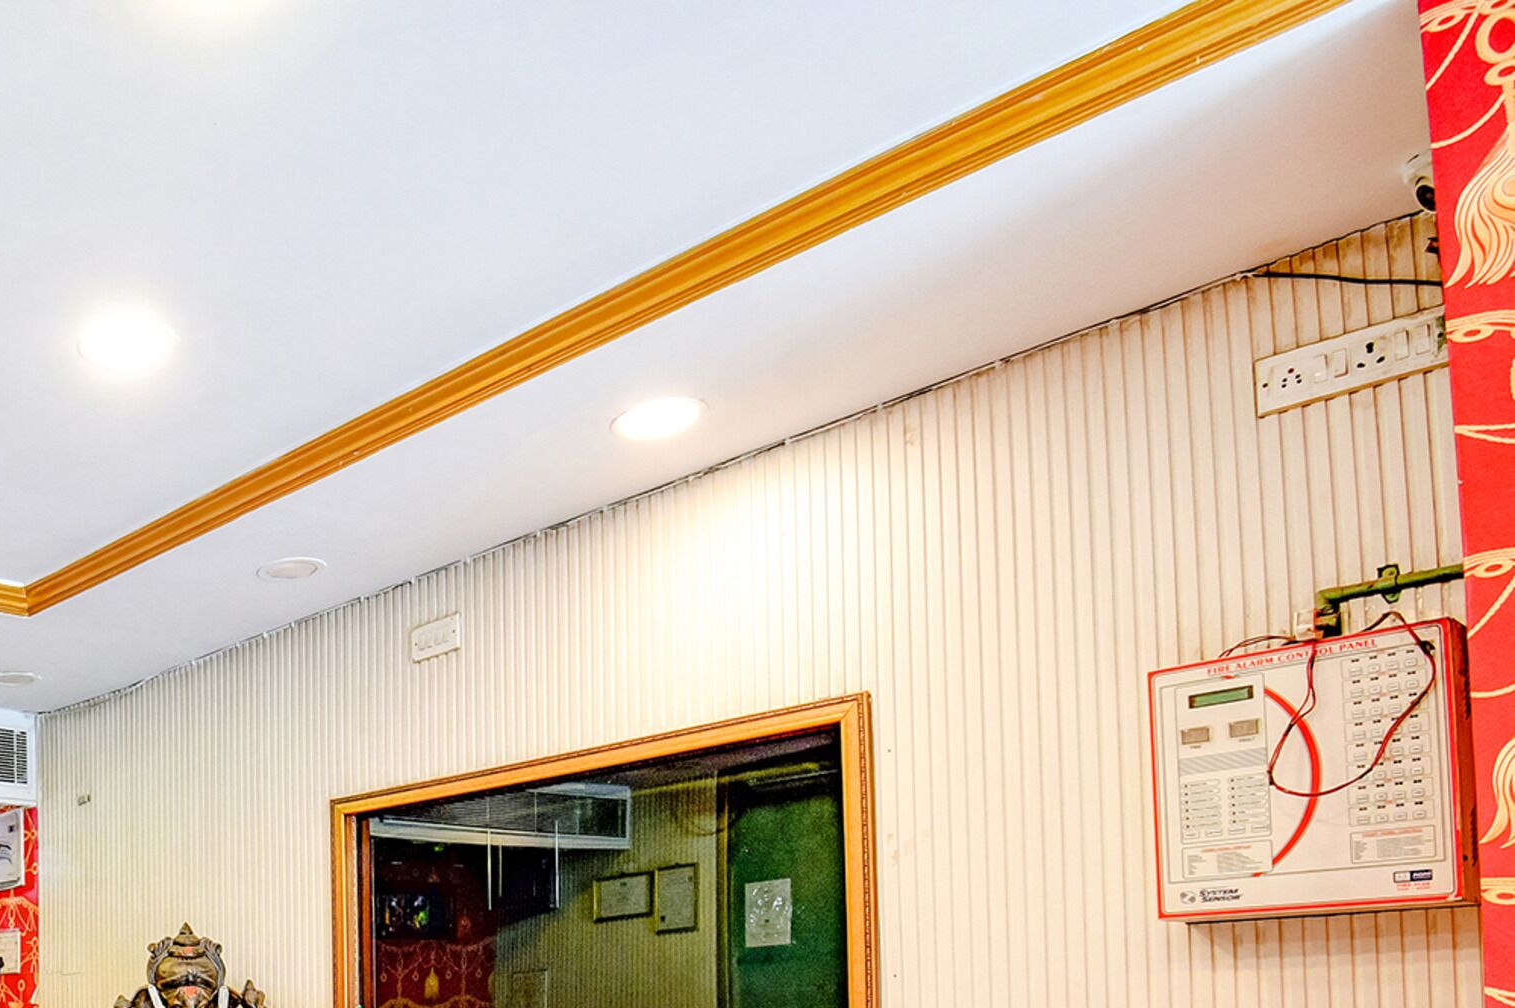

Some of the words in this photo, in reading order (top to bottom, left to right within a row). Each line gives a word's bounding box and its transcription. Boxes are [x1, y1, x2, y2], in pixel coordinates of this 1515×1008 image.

[1207, 664, 1231, 675] FIRE
[1236, 656, 1274, 671] ALARM
[1339, 639, 1377, 651] PANEL
